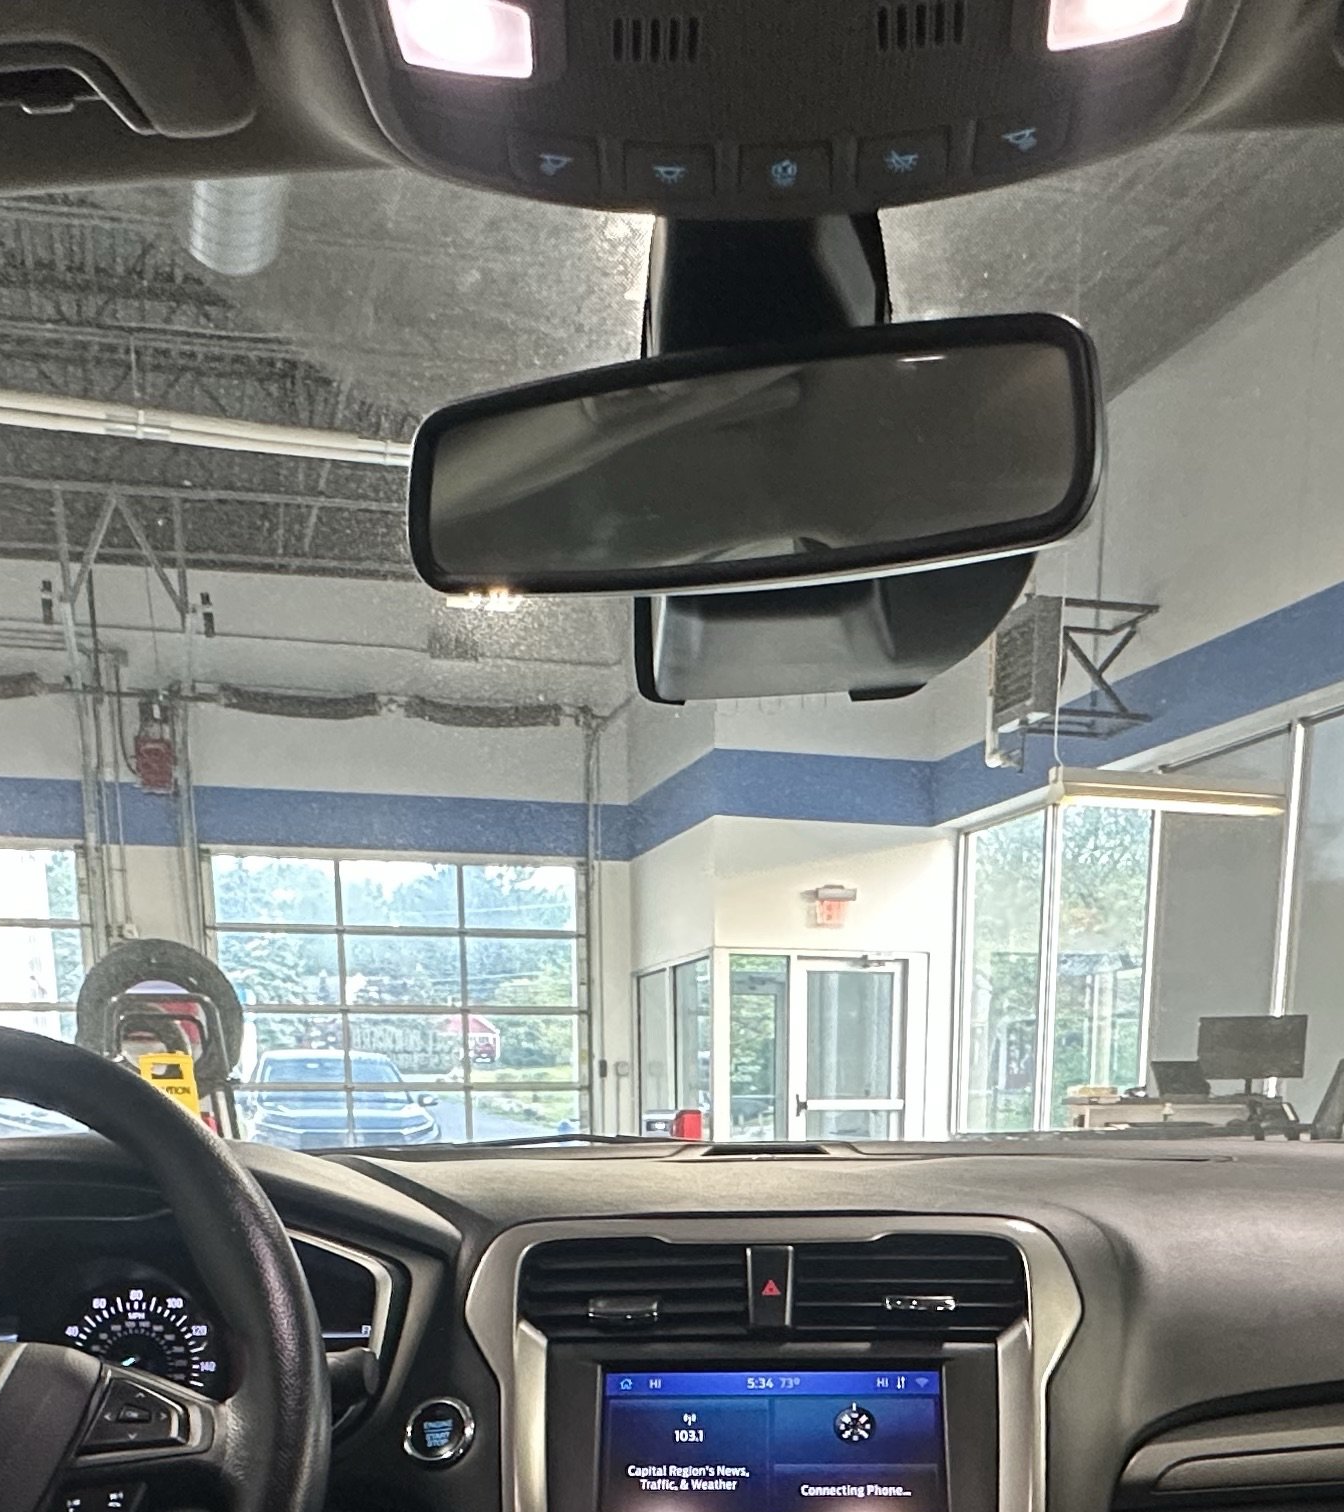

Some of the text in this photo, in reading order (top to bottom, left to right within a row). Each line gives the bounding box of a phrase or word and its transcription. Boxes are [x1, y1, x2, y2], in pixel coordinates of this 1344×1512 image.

[649, 1379, 662, 1389] HI
[747, 1377, 774, 1389] 5:34
[876, 1377, 889, 1387] HI
[674, 1429, 704, 1443] 103.1
[627, 1465, 750, 1478] Capital Region's News,
[640, 1478, 738, 1491] Traffic, & Weather
[800, 1484, 865, 1498] Connecting
